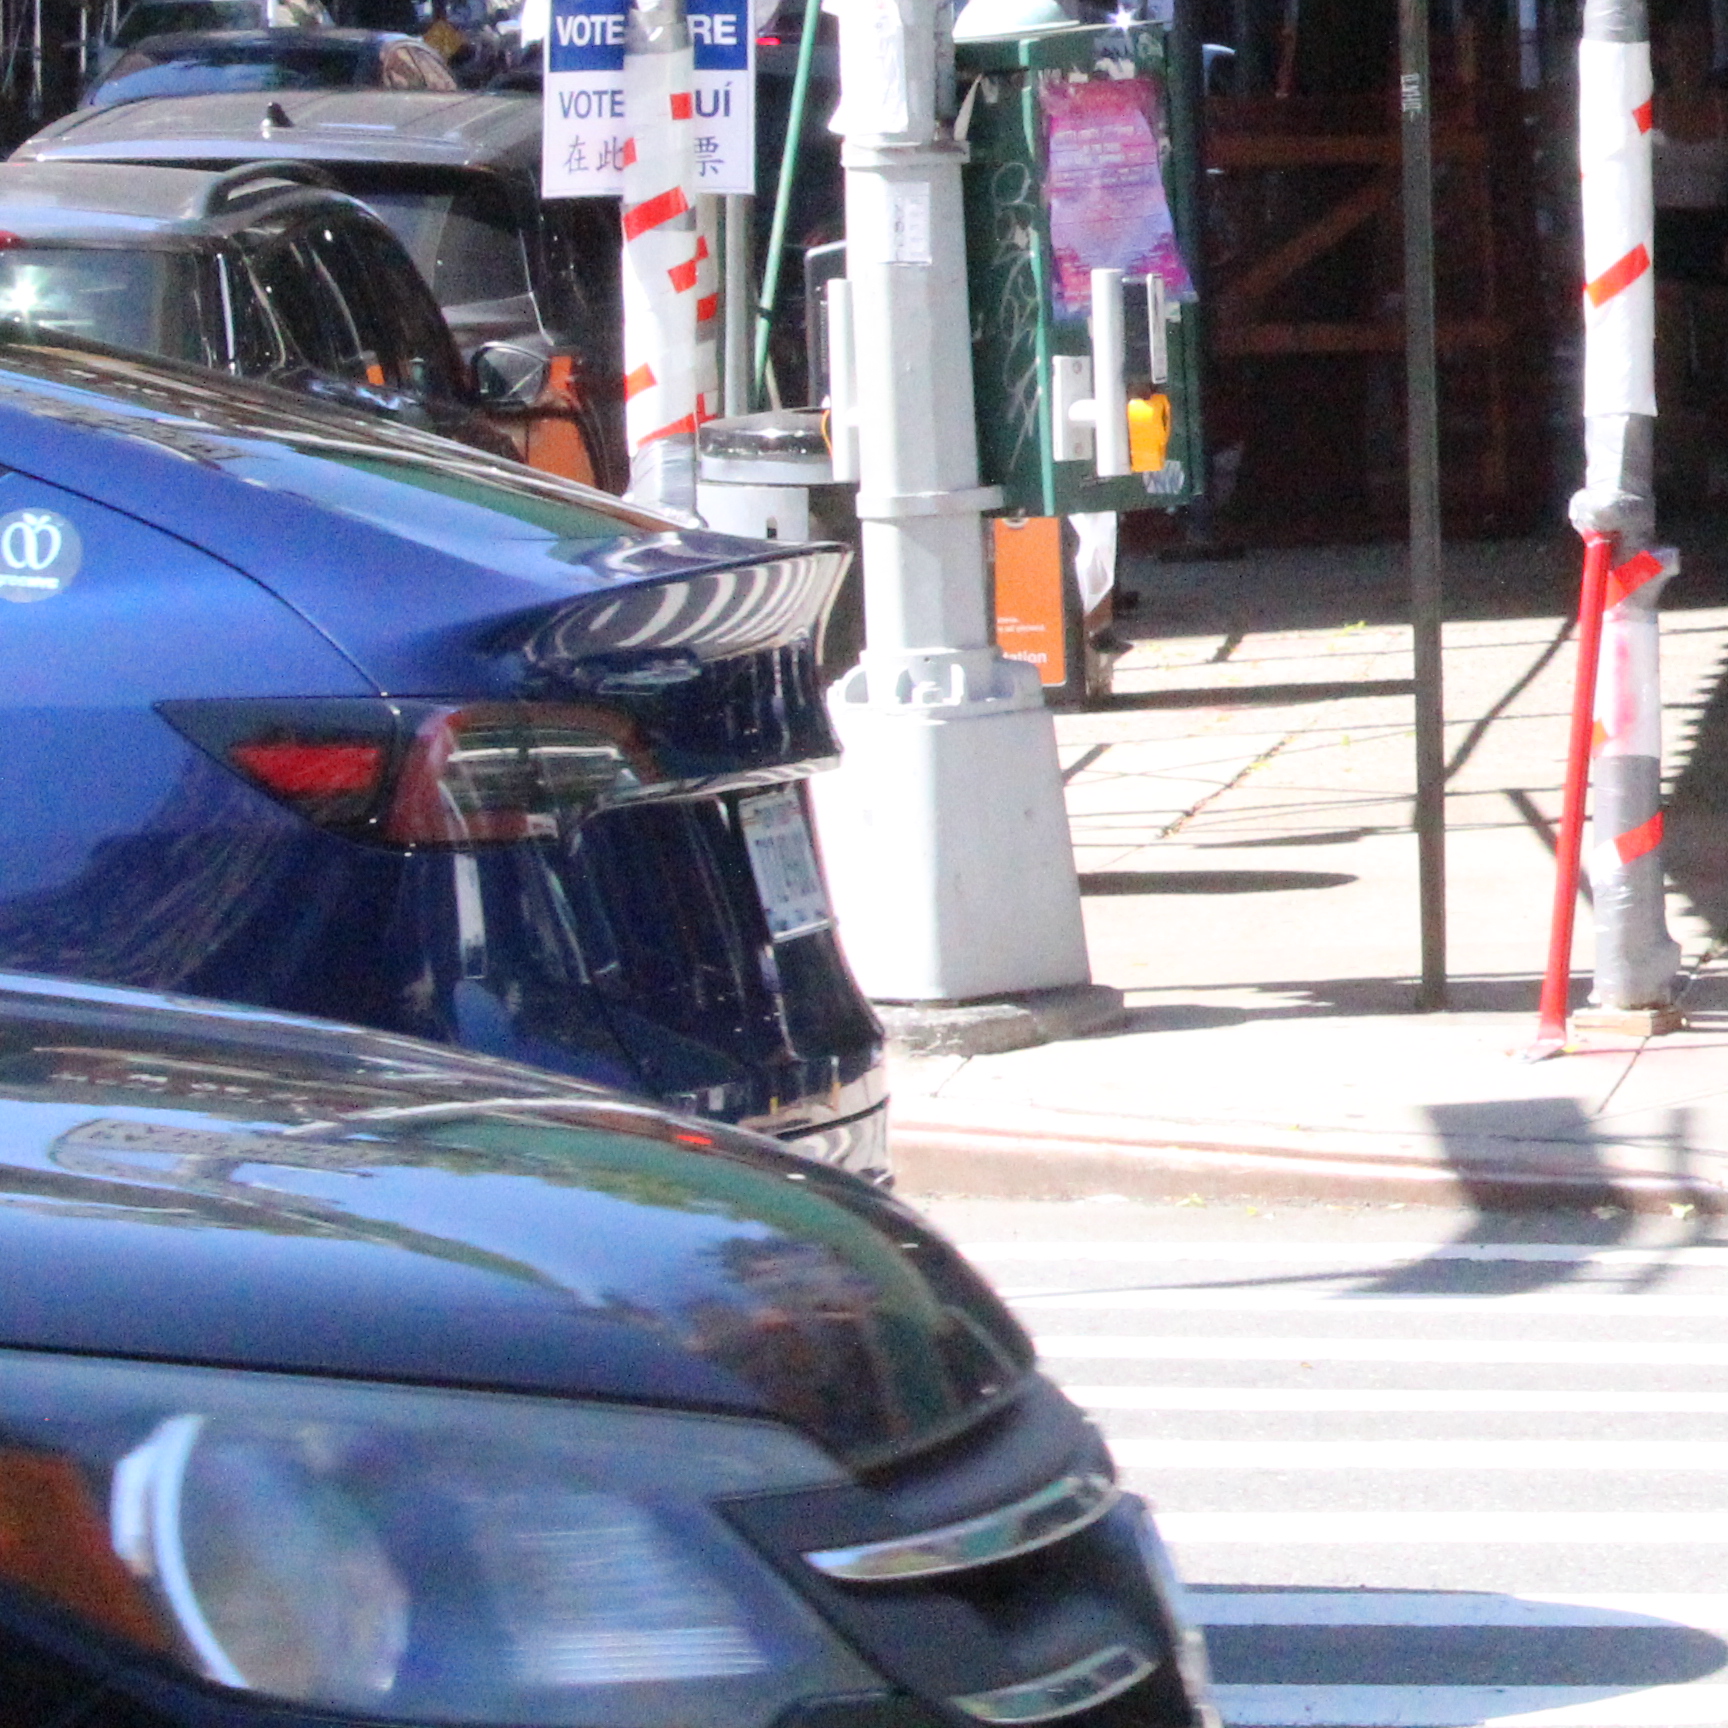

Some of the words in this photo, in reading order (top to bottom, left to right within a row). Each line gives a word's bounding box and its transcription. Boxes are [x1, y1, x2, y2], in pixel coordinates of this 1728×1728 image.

[555, 14, 625, 47] VOTE
[686, 14, 738, 46] RE
[559, 90, 625, 120] VOTE
[694, 81, 732, 118] UÍ
[564, 134, 725, 178] 在此票
